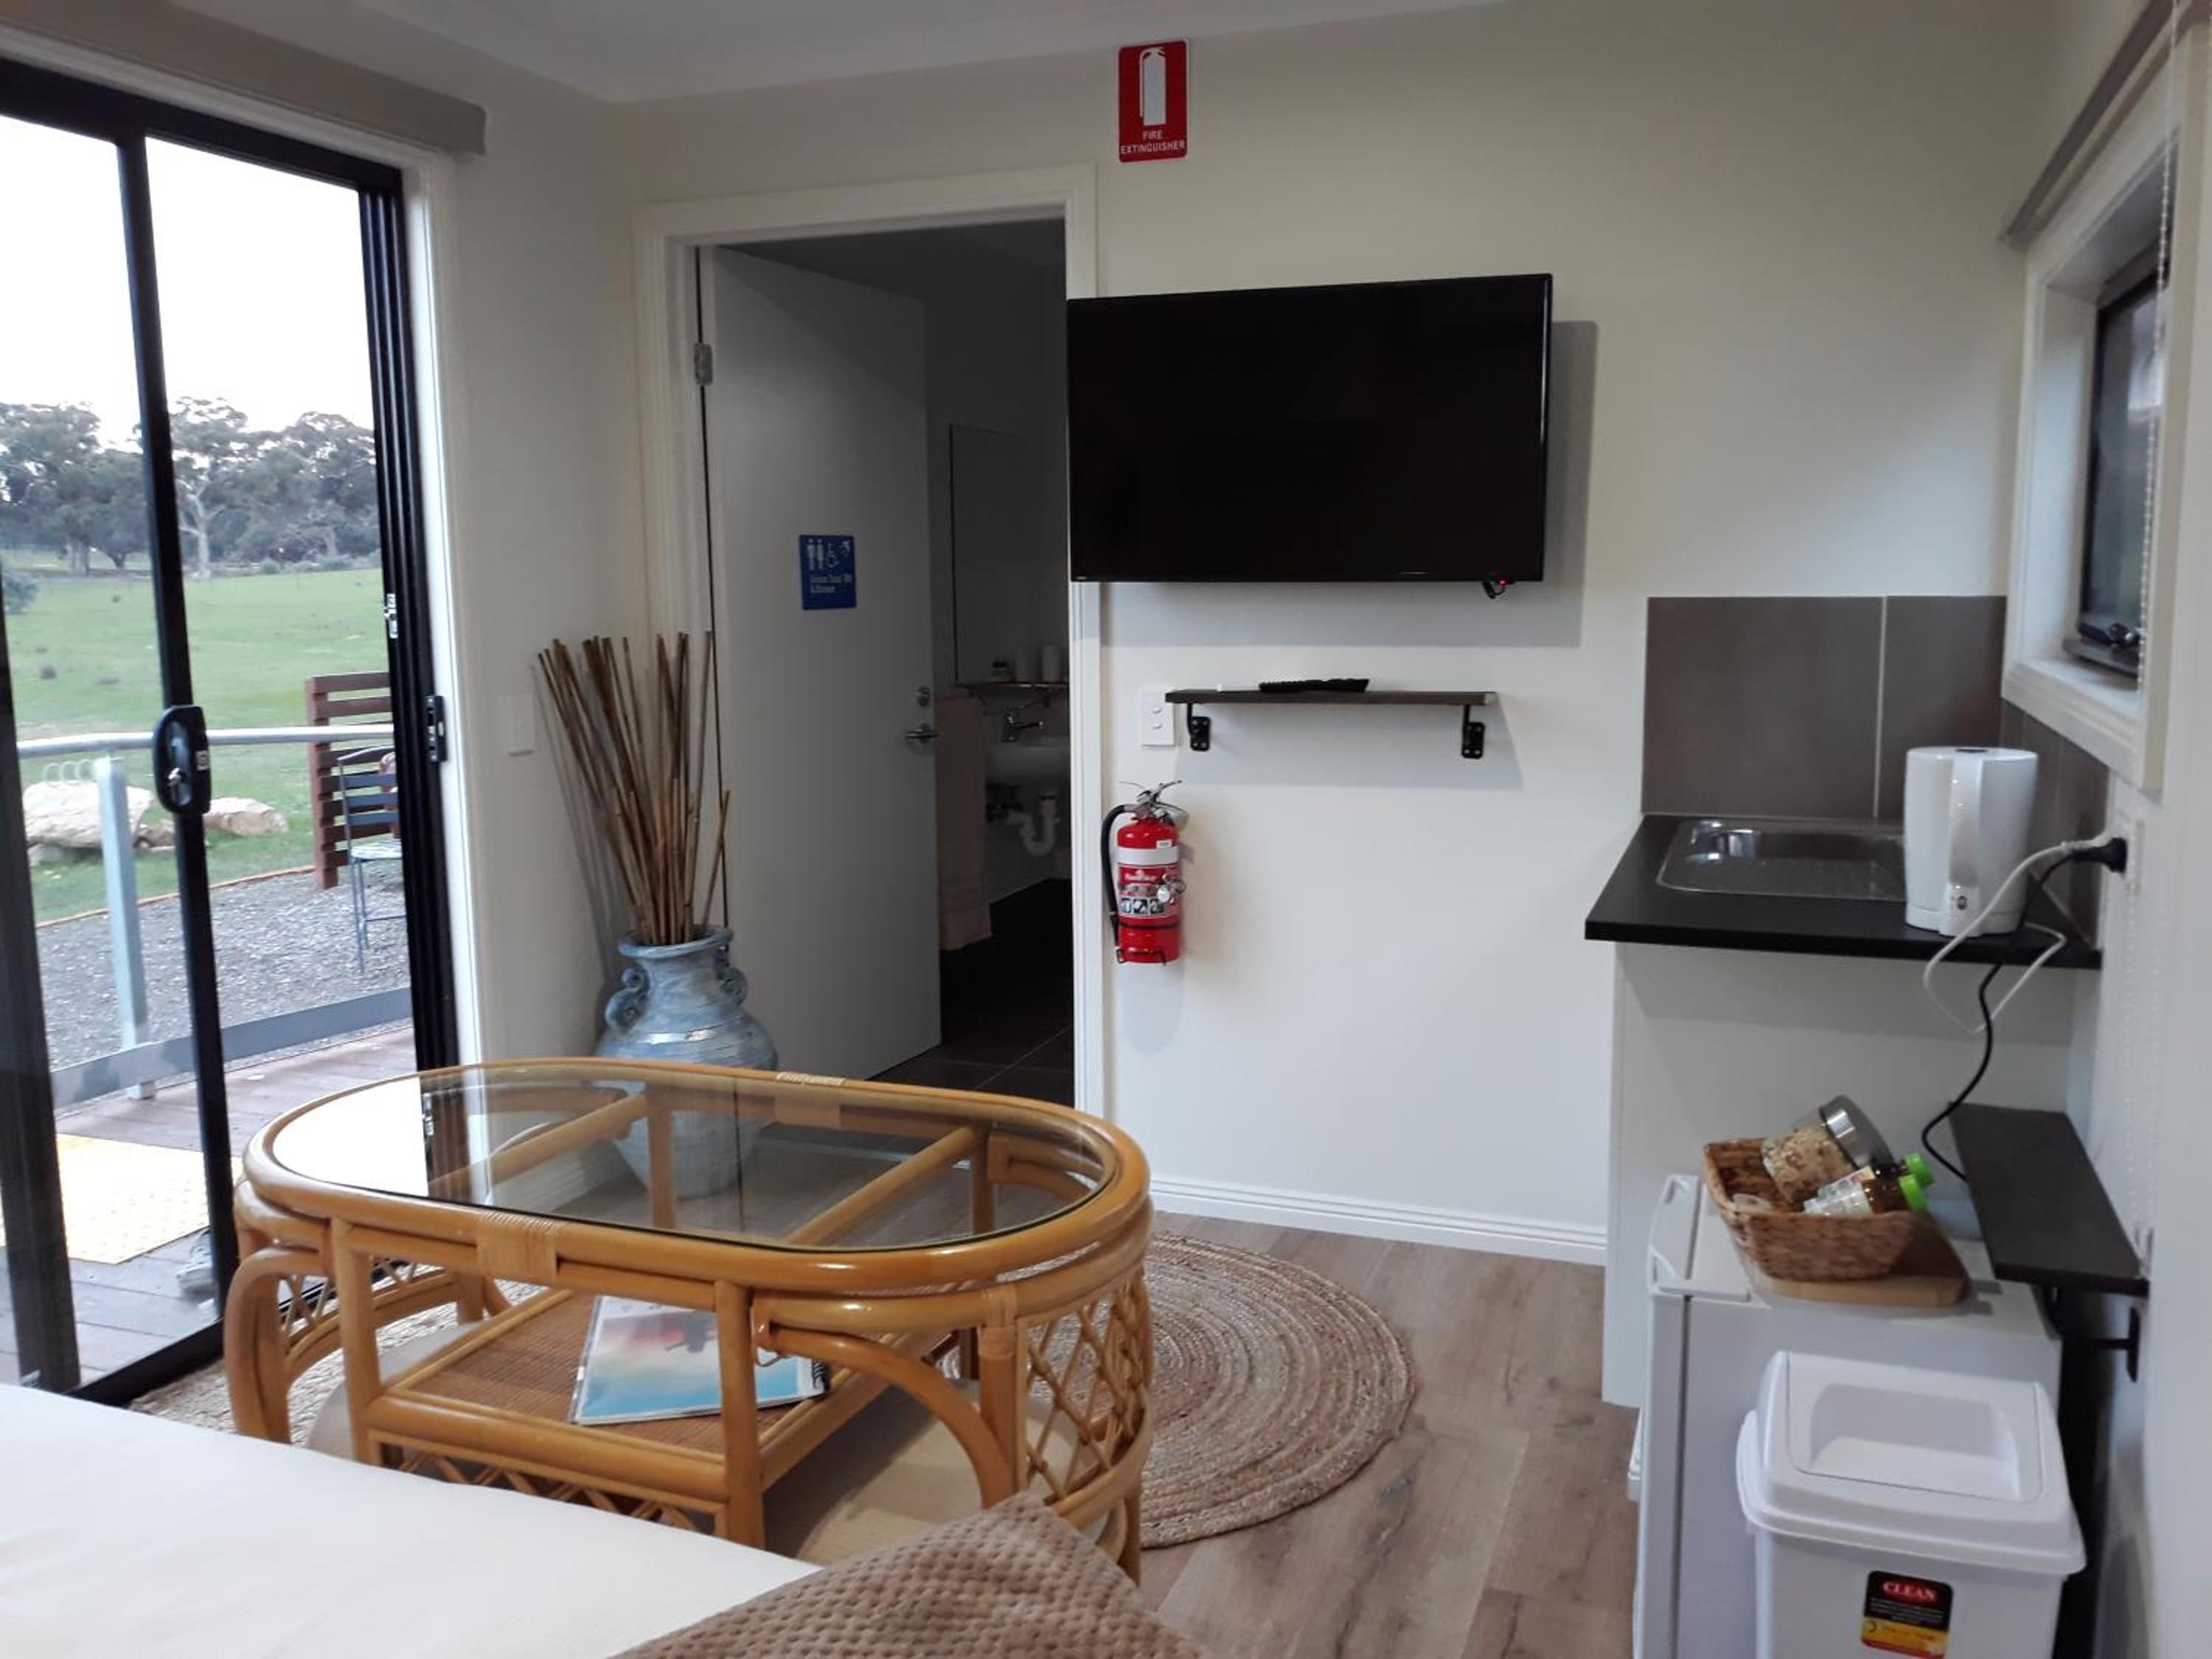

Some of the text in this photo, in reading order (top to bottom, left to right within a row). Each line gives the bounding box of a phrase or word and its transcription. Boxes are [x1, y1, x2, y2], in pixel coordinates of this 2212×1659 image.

[1143, 130, 1163, 139] FIRE
[1120, 140, 1185, 153] EXTINGUISHER
[1882, 1581, 1935, 1599] CLEAN
